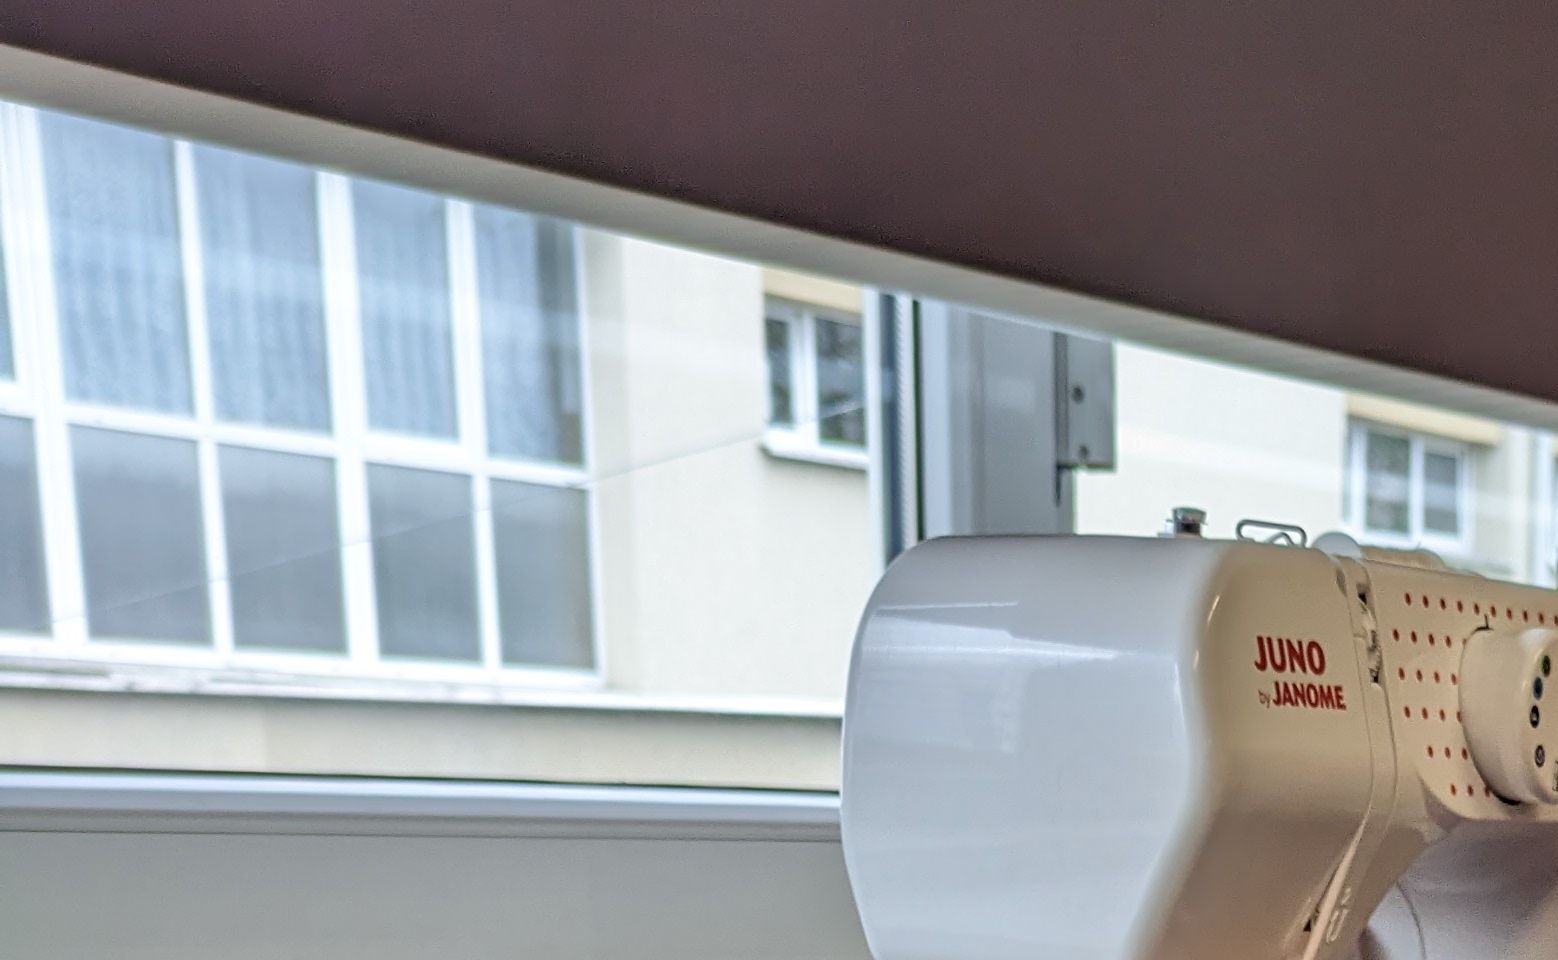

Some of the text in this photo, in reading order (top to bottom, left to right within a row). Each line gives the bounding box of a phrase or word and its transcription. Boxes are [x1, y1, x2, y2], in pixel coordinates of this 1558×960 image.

[1255, 635, 1326, 675] JUNO
[1258, 681, 1346, 710] by JANOME
